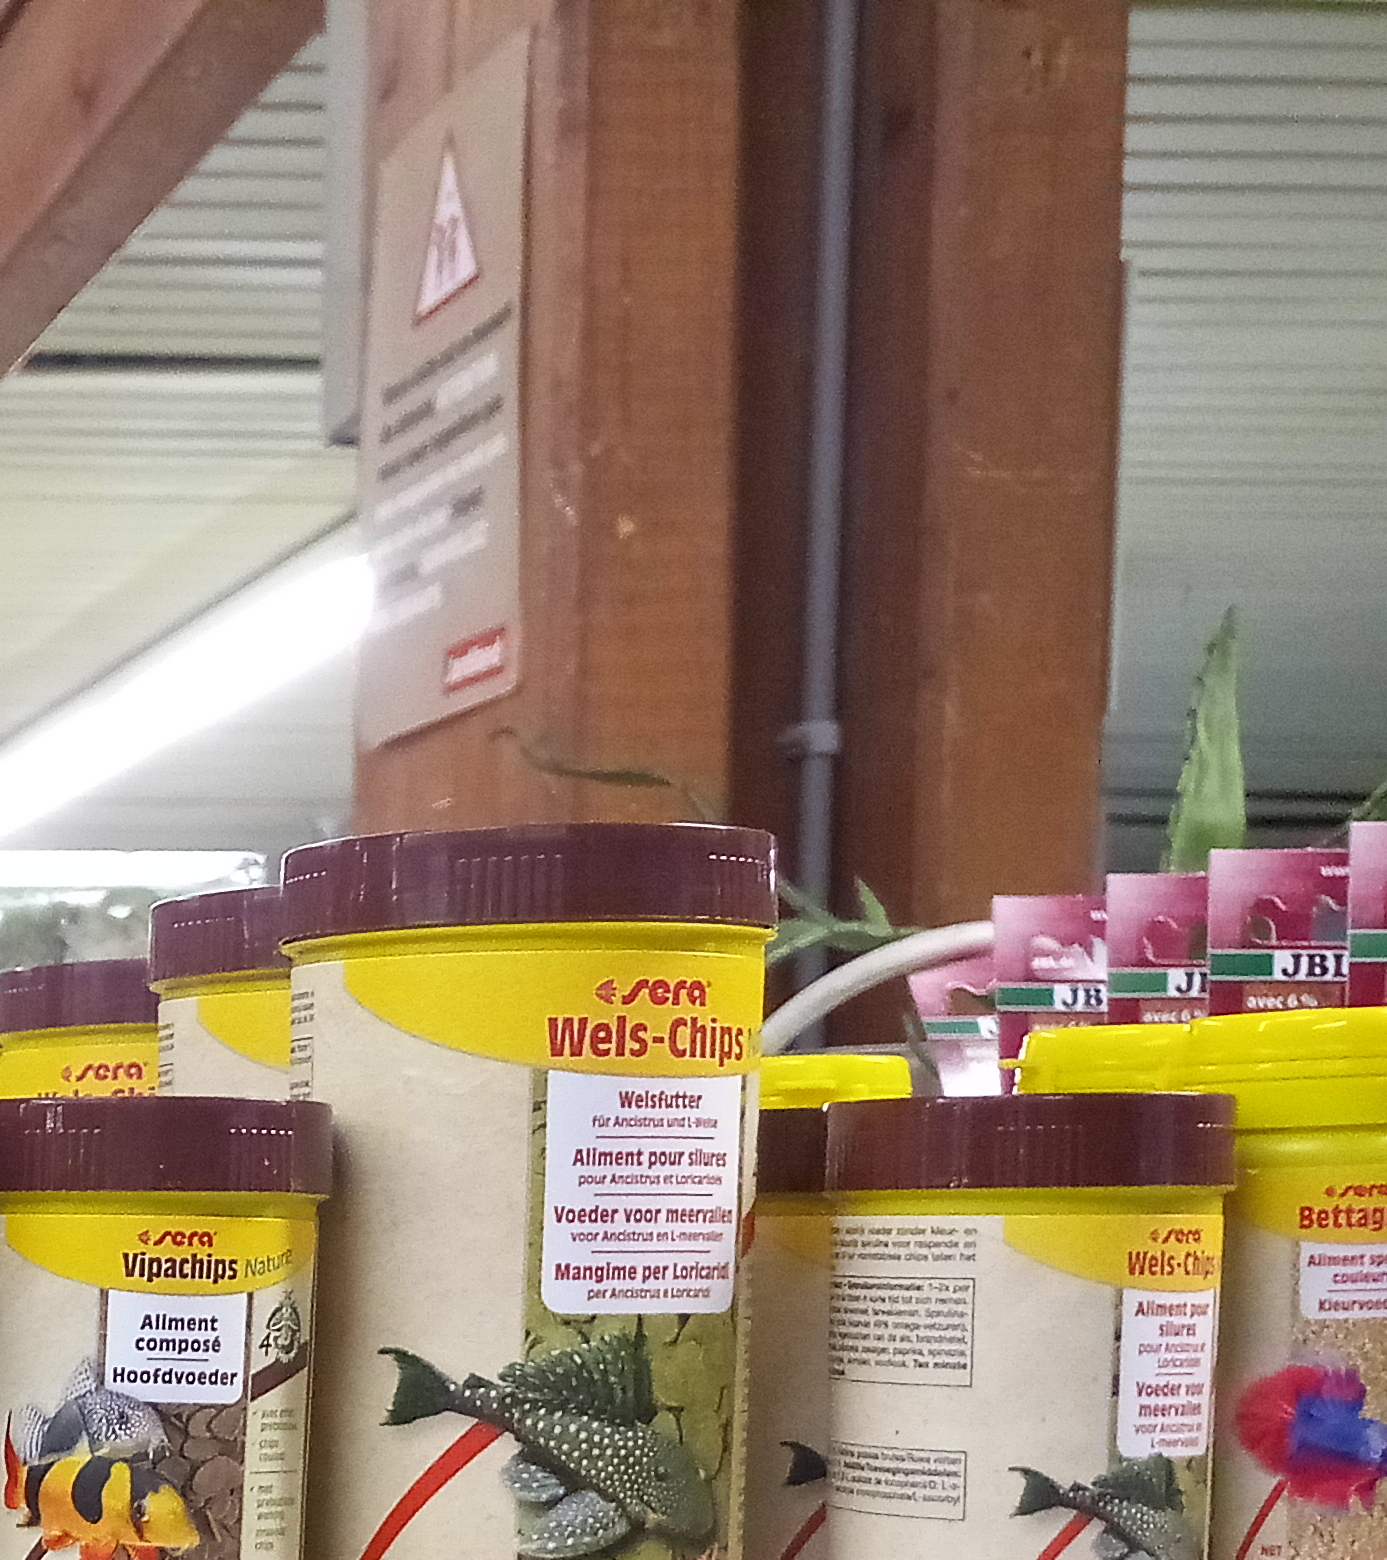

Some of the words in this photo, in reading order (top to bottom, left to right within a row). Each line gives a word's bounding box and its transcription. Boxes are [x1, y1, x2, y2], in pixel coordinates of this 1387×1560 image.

[621, 978, 708, 1007] sera
[547, 1015, 744, 1068] Wels-Chips
[74, 1062, 143, 1081] sera
[618, 1090, 703, 1109] Welsfutter
[572, 1148, 643, 1167] Aliment
[648, 1151, 685, 1169] pour
[688, 1149, 727, 1167] silures
[554, 1205, 619, 1224] Voeder
[624, 1208, 661, 1224] voor
[153, 1231, 214, 1248] sera
[122, 1252, 239, 1284] Vipachips
[140, 1313, 219, 1332] Aliment
[135, 1334, 221, 1354] composé
[111, 1366, 238, 1387] Hoofdvoeder
